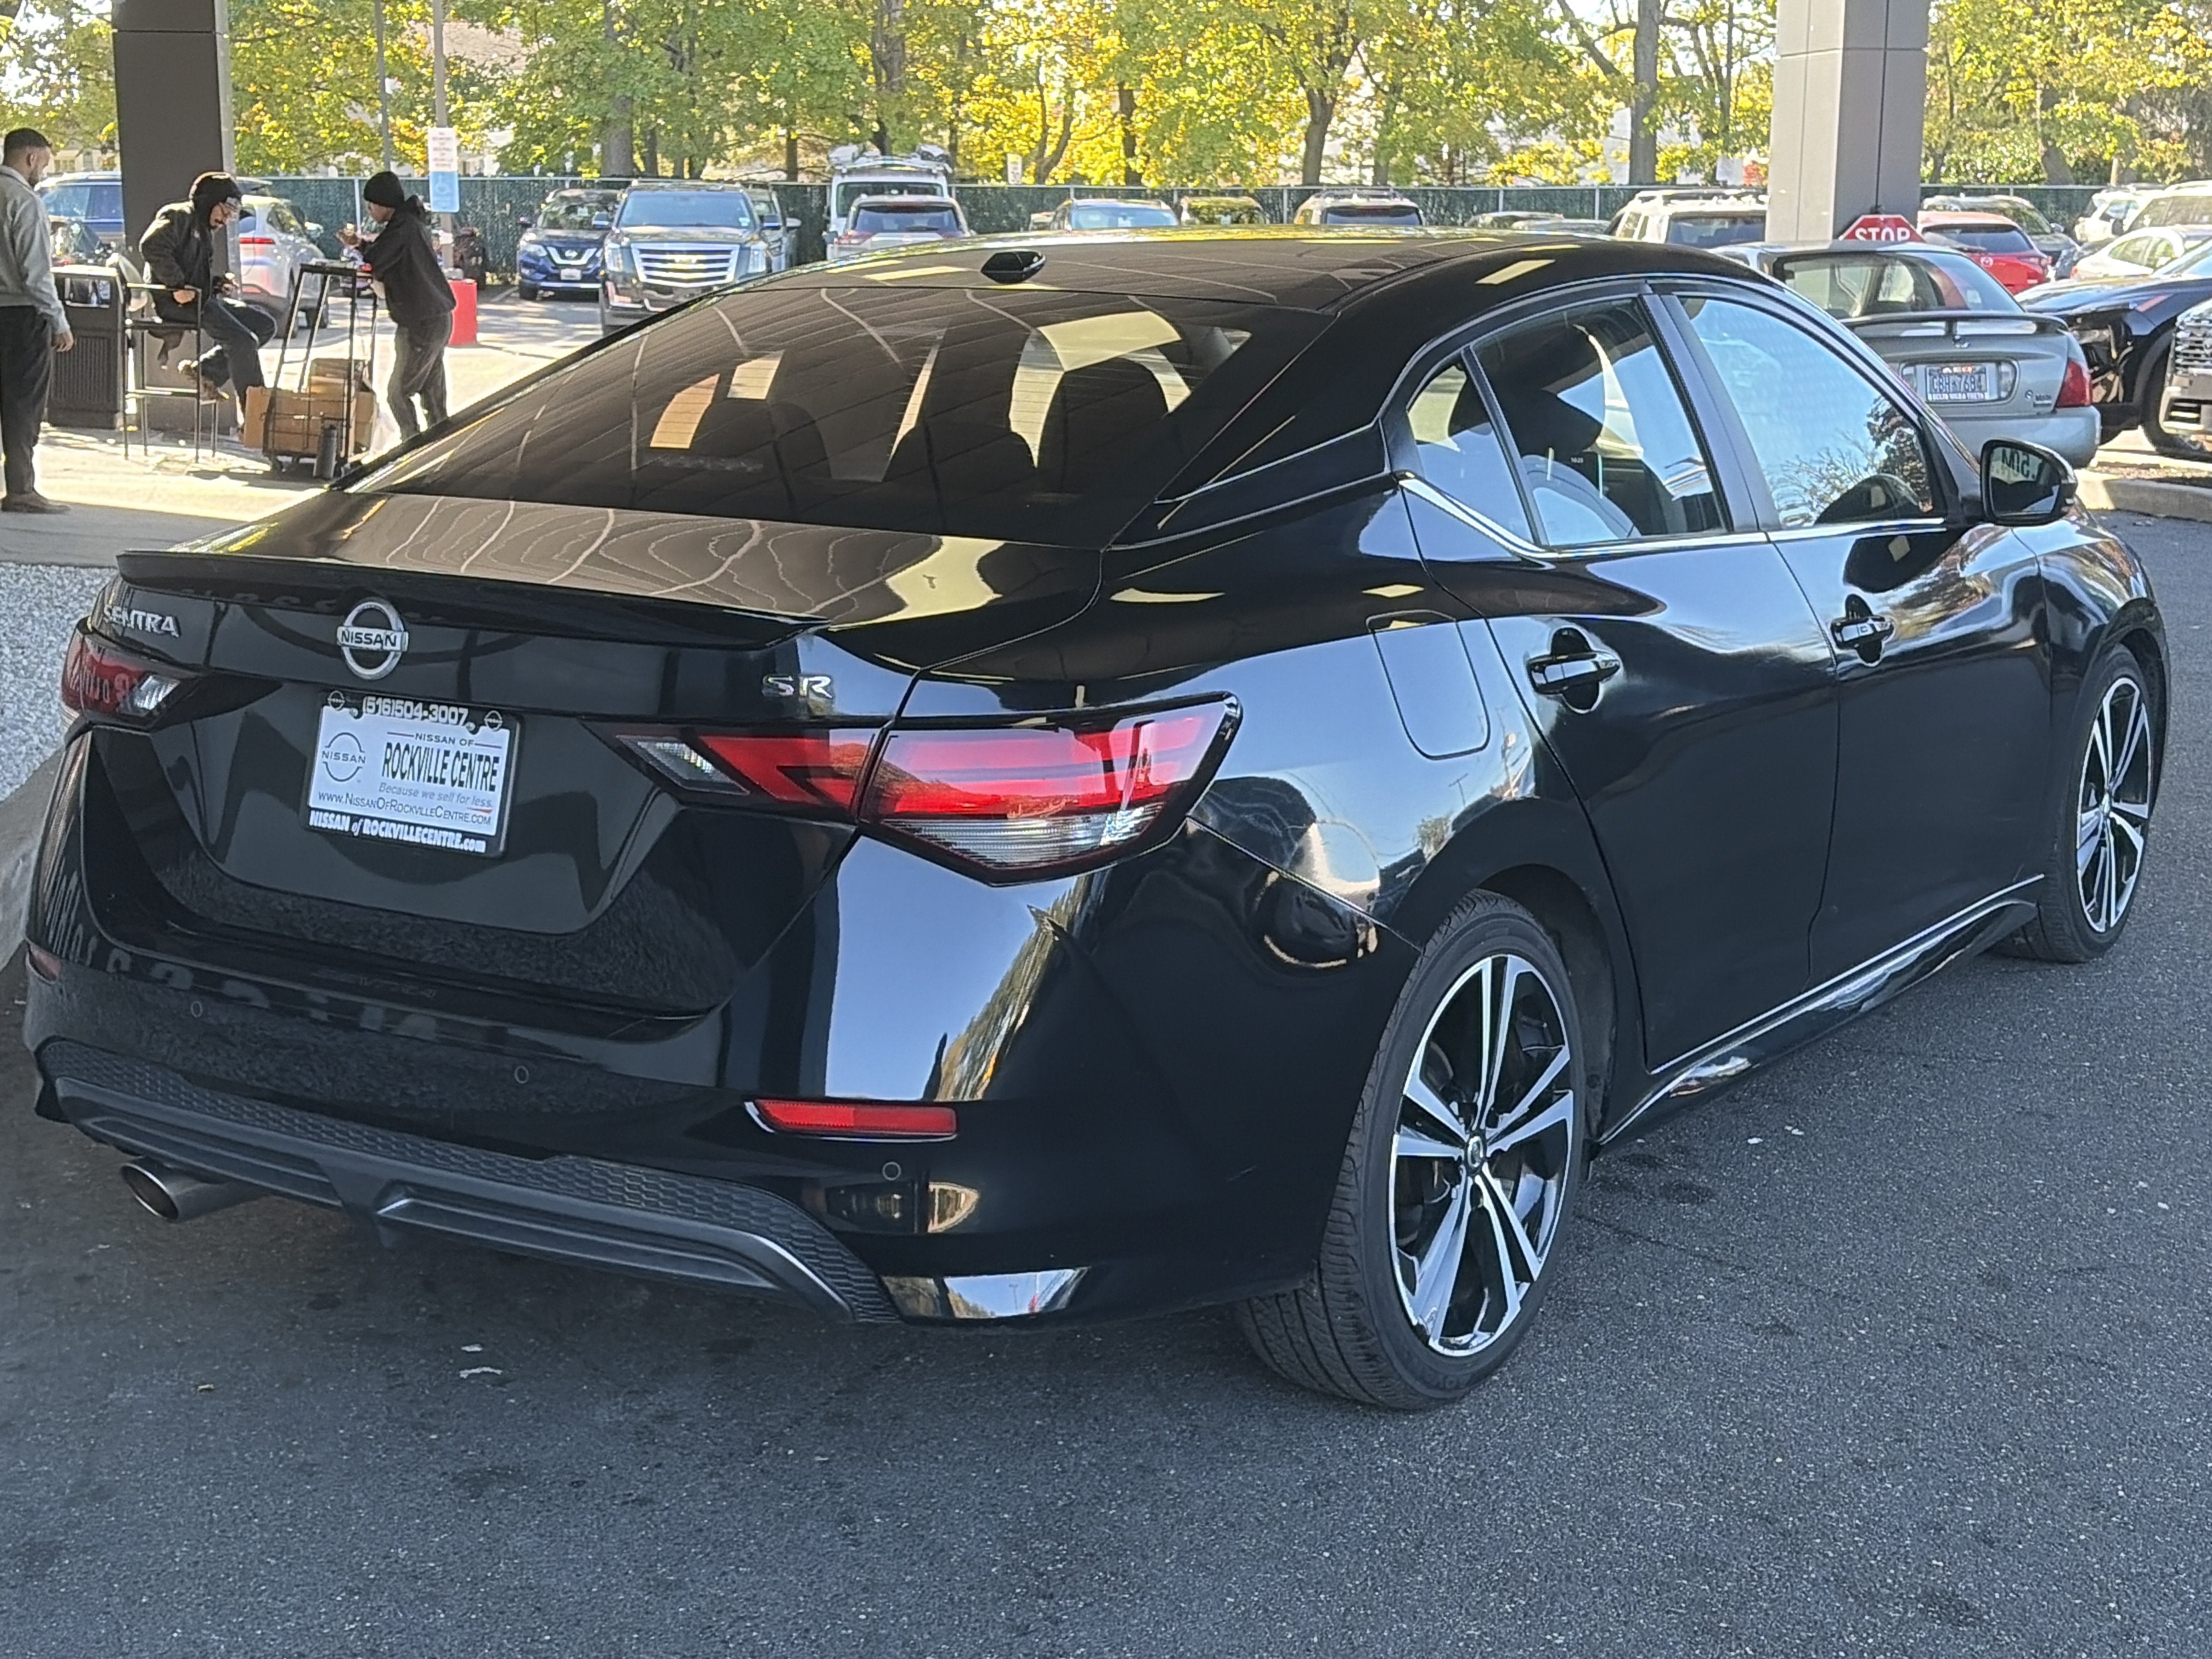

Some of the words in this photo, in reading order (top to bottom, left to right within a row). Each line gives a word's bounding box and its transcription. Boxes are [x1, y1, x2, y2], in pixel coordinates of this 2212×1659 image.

[1855, 227, 1910, 241] STOP
[103, 604, 180, 637] SENTRA
[341, 630, 397, 647] NISSAN
[761, 675, 833, 699] SR
[362, 696, 469, 726] (516)504-3007
[415, 732, 456, 745] NISSAN
[459, 738, 475, 747] OF
[321, 750, 366, 764] NISSAN
[381, 742, 450, 786] ROCKVILLE
[450, 750, 500, 792] CENTRE
[379, 782, 419, 797] Because
[421, 790, 436, 799] we
[437, 792, 455, 802] sell
[455, 793, 471, 805] for
[308, 810, 351, 832] NISSAN
[351, 817, 364, 837] of
[362, 818, 487, 853] ROCKVILLECENTRE.com
